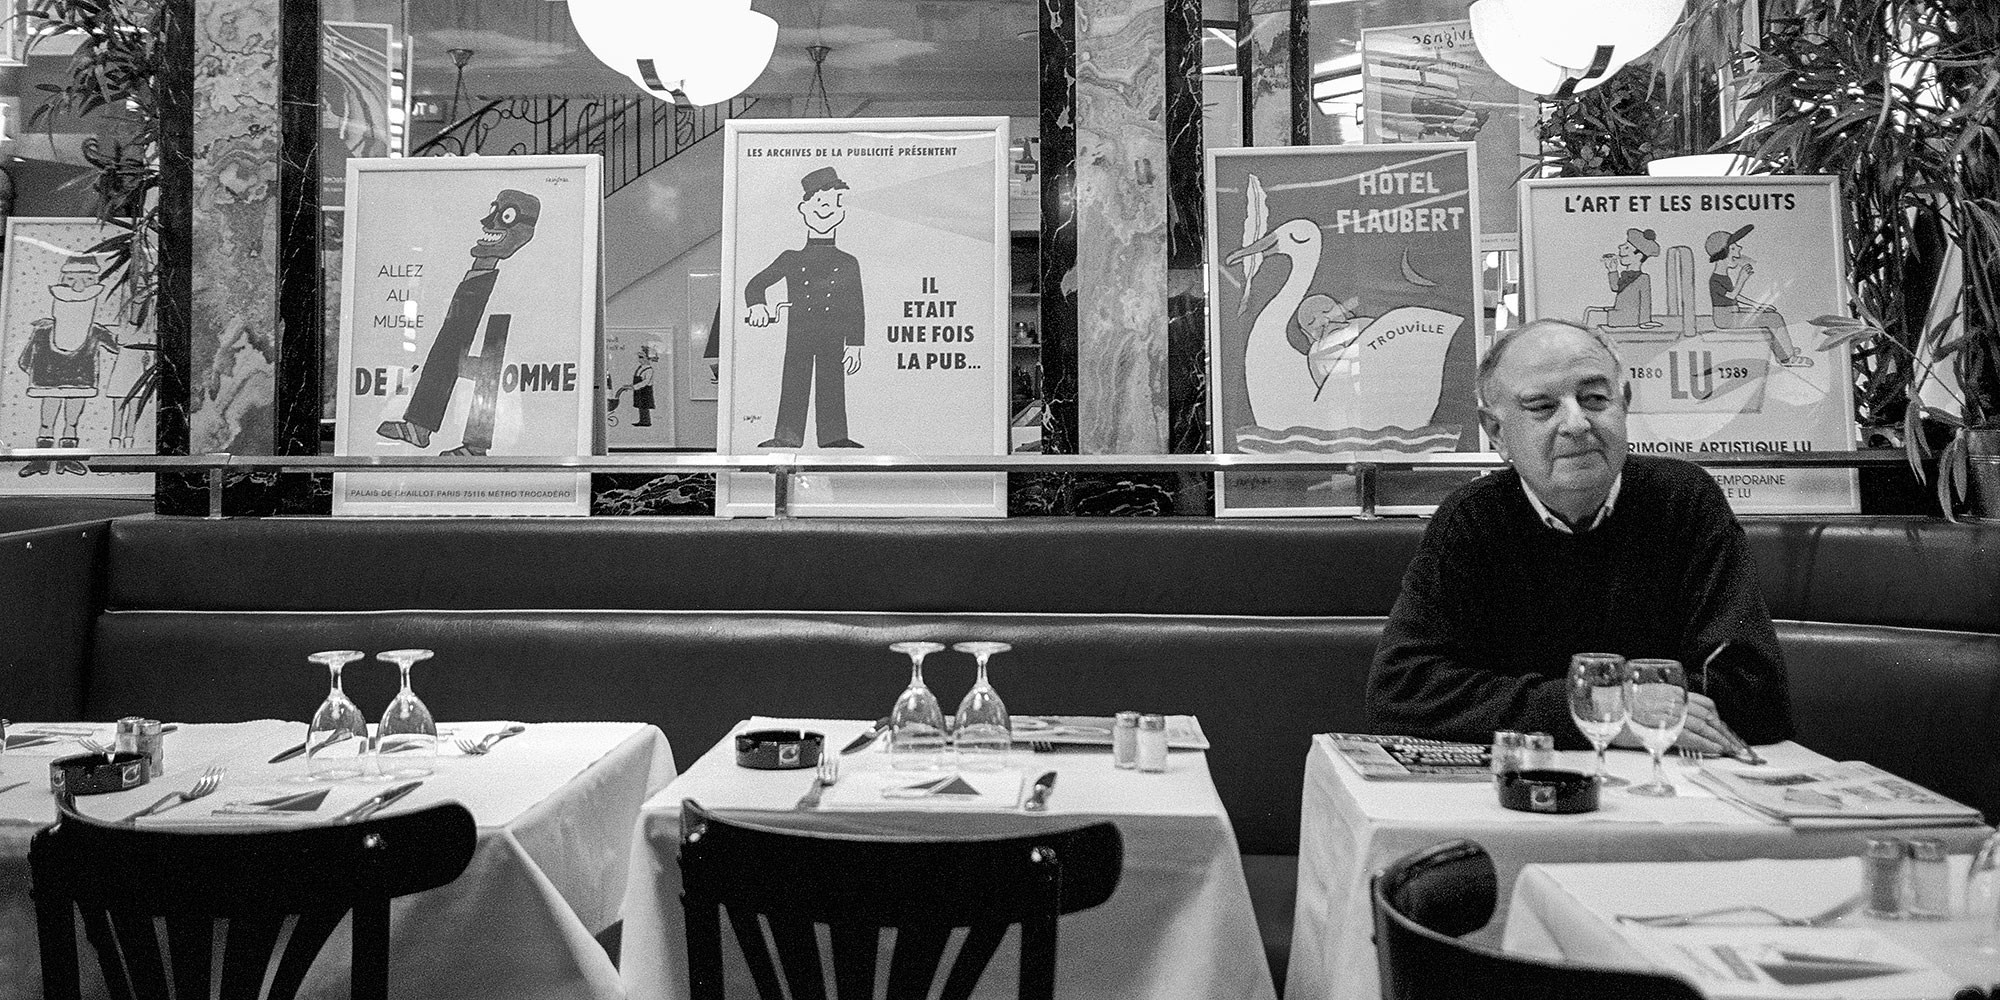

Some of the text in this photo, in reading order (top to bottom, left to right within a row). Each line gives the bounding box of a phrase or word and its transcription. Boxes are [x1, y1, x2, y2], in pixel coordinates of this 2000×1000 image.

[747, 145, 957, 157] LES ARCHIVES DE LA PUBLICITÉ PRÉSENTENT
[1565, 193, 1796, 213] L'ART ET LES BISCUITS
[1337, 207, 1464, 234] FLAUBERT
[378, 264, 424, 277] ALLEZ
[922, 277, 939, 294] IL
[387, 289, 410, 301] AU
[904, 301, 957, 318] ETAIT
[887, 325, 975, 343] UNE FOIS
[897, 352, 981, 370] LA PUB...
[355, 367, 388, 396] DE
[1630, 350, 1749, 400] 1880 LU 1989
[1627, 441, 1812, 453] RIMOINE ARTISTIQUE LU
[1715, 474, 1786, 485] EMPORAINE
[350, 489, 379, 497] PALAIS
[381, 489, 392, 497] DE
[436, 489, 460, 497] PARIS
[463, 490, 486, 498] 75116
[1738, 488, 1751, 498] LU
